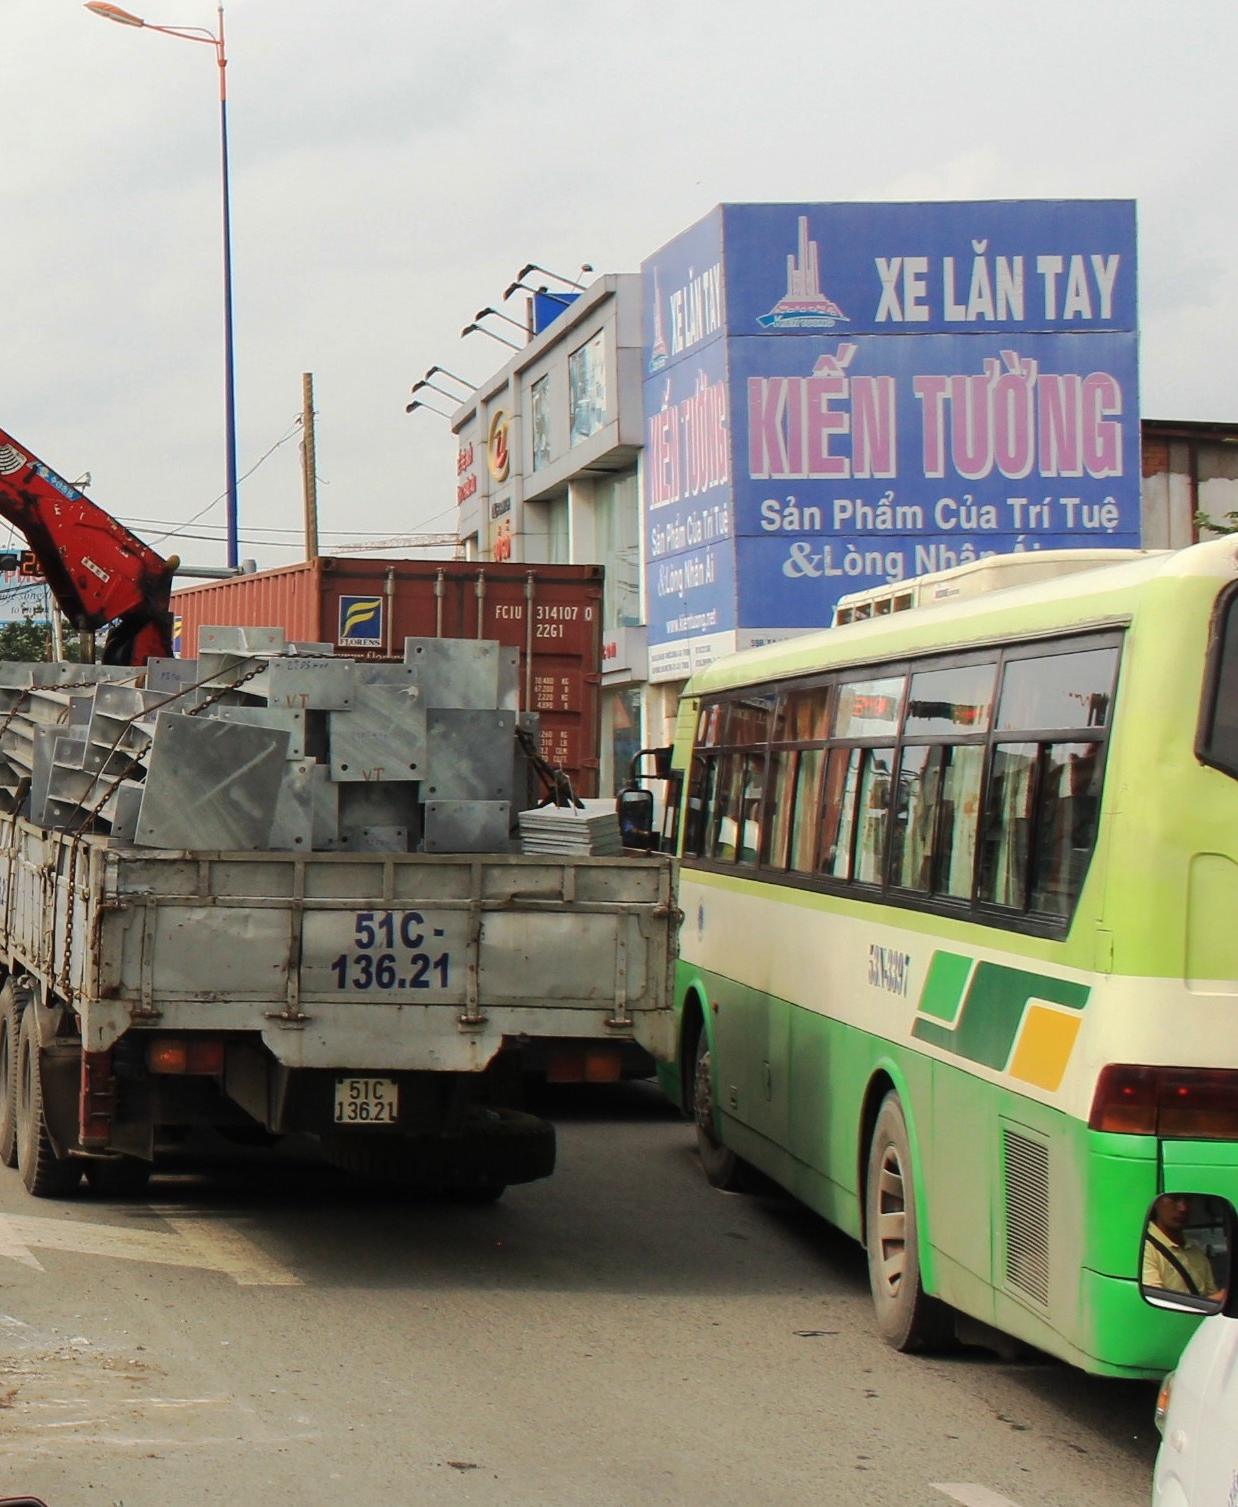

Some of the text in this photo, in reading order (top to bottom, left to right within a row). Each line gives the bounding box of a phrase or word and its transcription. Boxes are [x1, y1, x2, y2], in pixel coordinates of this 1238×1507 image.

[874, 239, 1120, 322] XE LĂN TAY
[670, 290, 684, 356] XE
[702, 262, 721, 335] TAY
[747, 343, 1124, 480] KIẾN TƯỜNG
[760, 491, 1119, 533] Sản Phẩm Của Trí Tuệ
[495, 605, 522, 620] FCIU
[536, 606, 578, 620] 314107
[340, 637, 382, 647] FLORENS
[536, 624, 563, 638] 22G1
[331, 953, 449, 989] 136.21
[349, 1080, 384, 1100] 51C
[337, 1101, 396, 1121] 136.21
